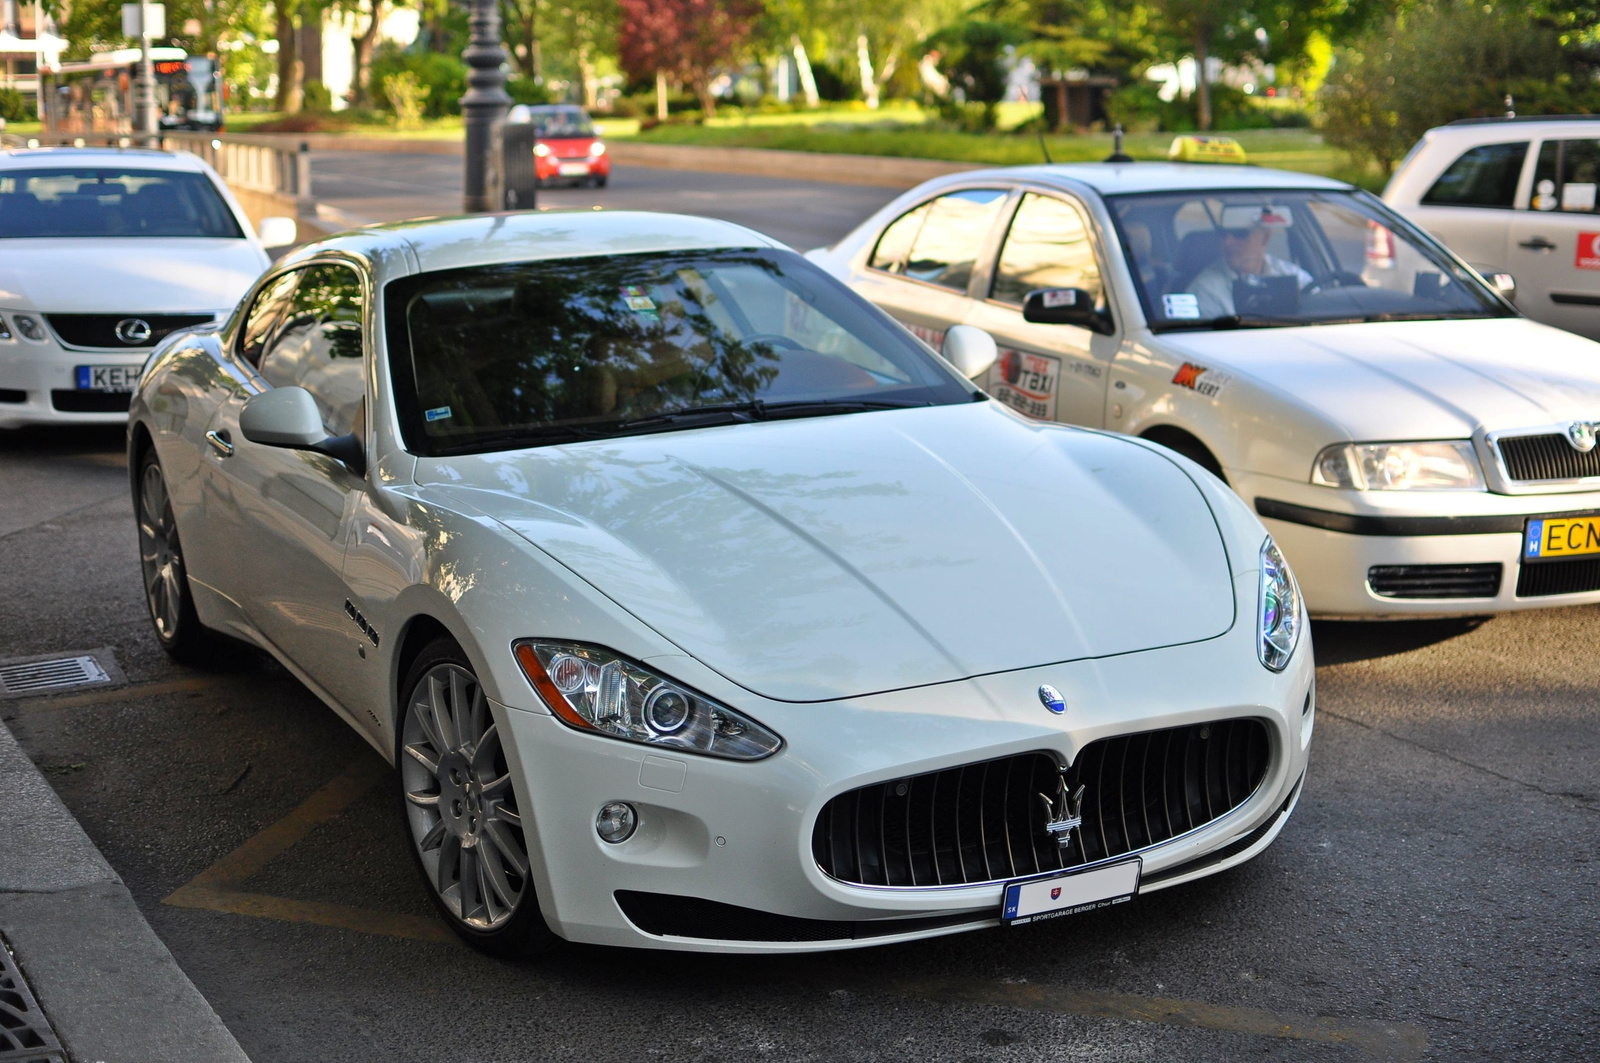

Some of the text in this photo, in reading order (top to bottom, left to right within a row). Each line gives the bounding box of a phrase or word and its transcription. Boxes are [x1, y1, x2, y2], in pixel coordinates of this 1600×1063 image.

[94, 368, 138, 386] KEH
[1529, 540, 1538, 553] H
[1007, 906, 1017, 914] SK
[1032, 909, 1073, 922] SPORTGARAGE
[1074, 903, 1096, 913] BERGER
